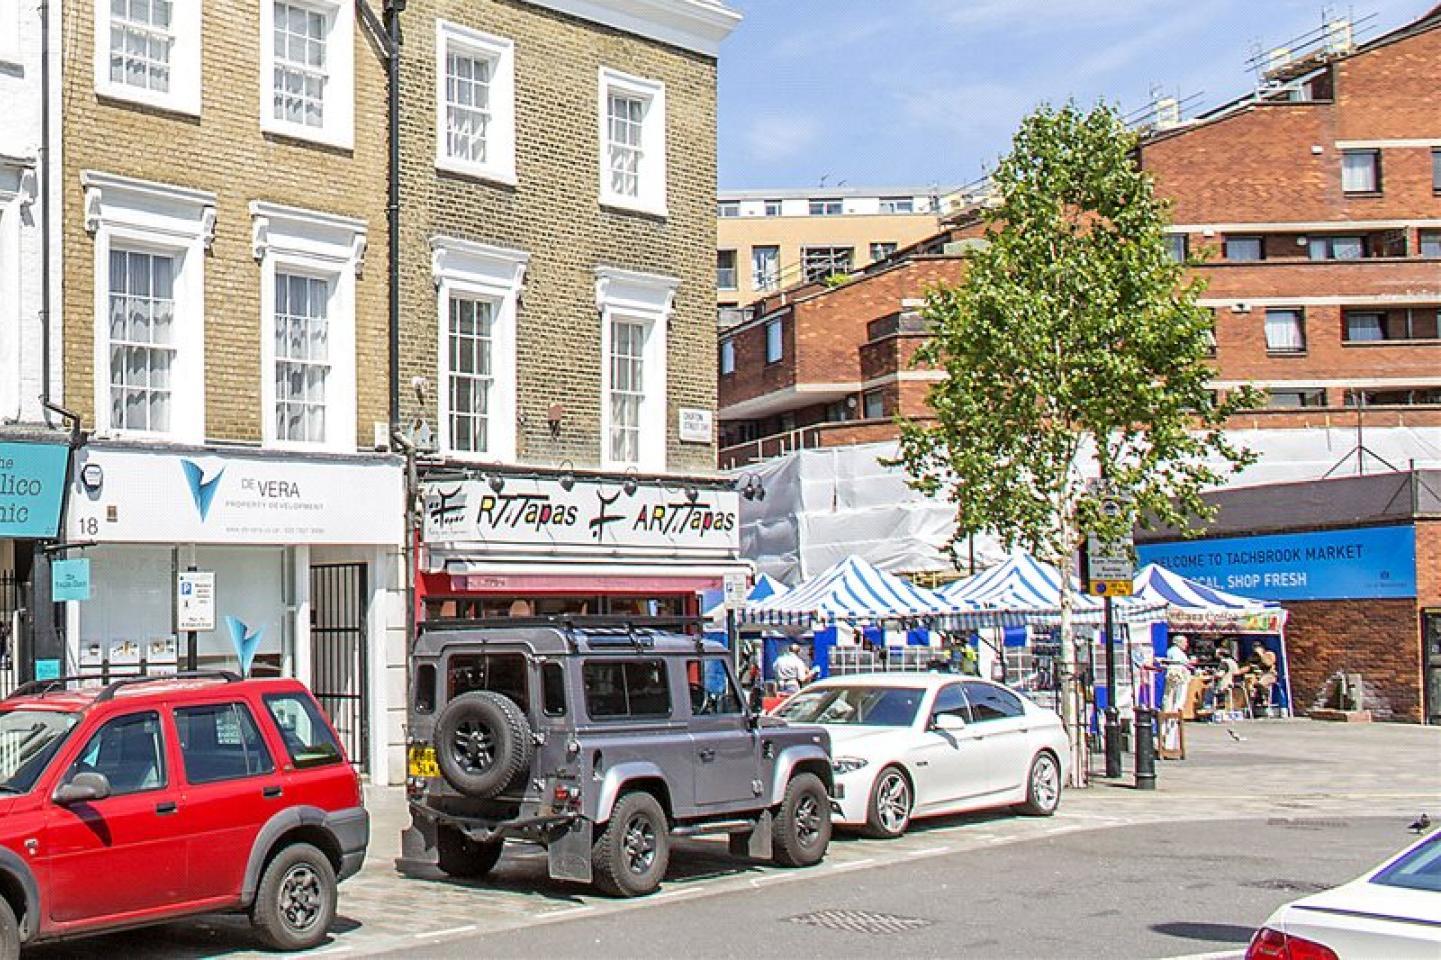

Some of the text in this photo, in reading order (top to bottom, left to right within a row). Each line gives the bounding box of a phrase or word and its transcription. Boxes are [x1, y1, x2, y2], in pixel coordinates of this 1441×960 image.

[241, 478, 301, 499] DE VERA
[79, 516, 99, 536] 18
[1209, 554, 1222, 566] TO
[1227, 548, 1301, 565] TACHBROOK
[1308, 544, 1364, 560] MARKET
[1227, 574, 1261, 589] SHOP
[1263, 571, 1307, 587] FRESH
